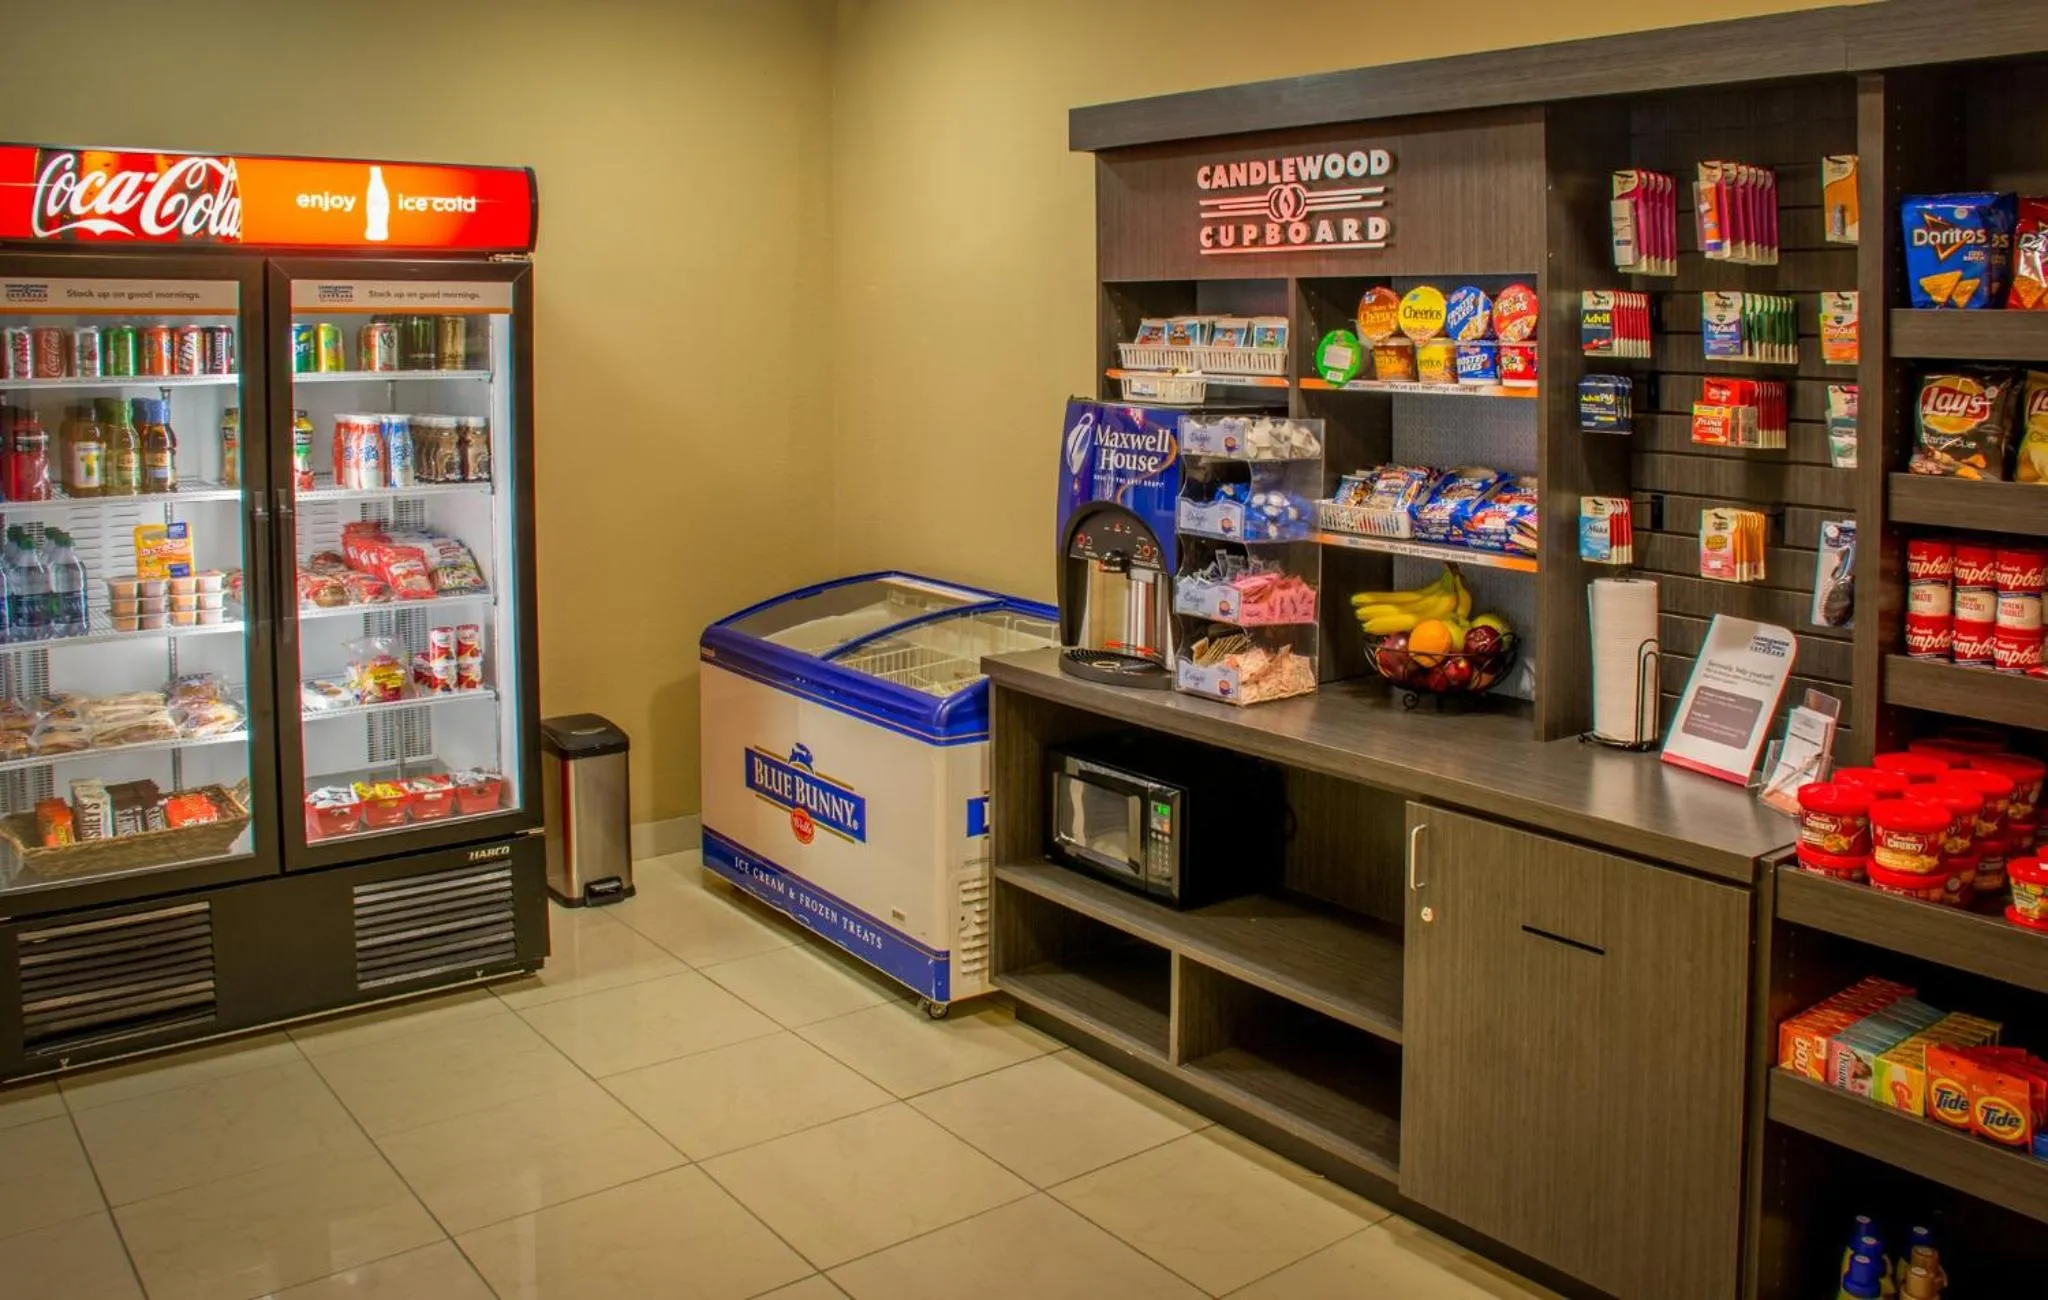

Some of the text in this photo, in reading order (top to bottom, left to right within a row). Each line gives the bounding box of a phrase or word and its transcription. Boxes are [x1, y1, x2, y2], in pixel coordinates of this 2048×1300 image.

[1196, 149, 1391, 189] CANDLEWOOD
[31, 153, 242, 237] Coca-Cola
[296, 191, 357, 213] enjoy
[398, 194, 477, 213] ice cold
[1199, 216, 1390, 248] CUPBOARD
[1912, 228, 1987, 247] Doritos
[97, 290, 110, 300] up
[1403, 305, 1443, 321] Cheerios
[1583, 312, 1610, 325] Advil
[1094, 424, 1171, 453] Maxwell
[1100, 448, 1159, 473] House
[754, 757, 855, 829] BLUE BUNNY
[1887, 838, 1923, 853] CHUNKY
[735, 856, 883, 950] ICE CREAM & FROZEN TREATS
[1935, 1087, 1970, 1111] Tide
[1981, 1104, 2021, 1128] Tide
